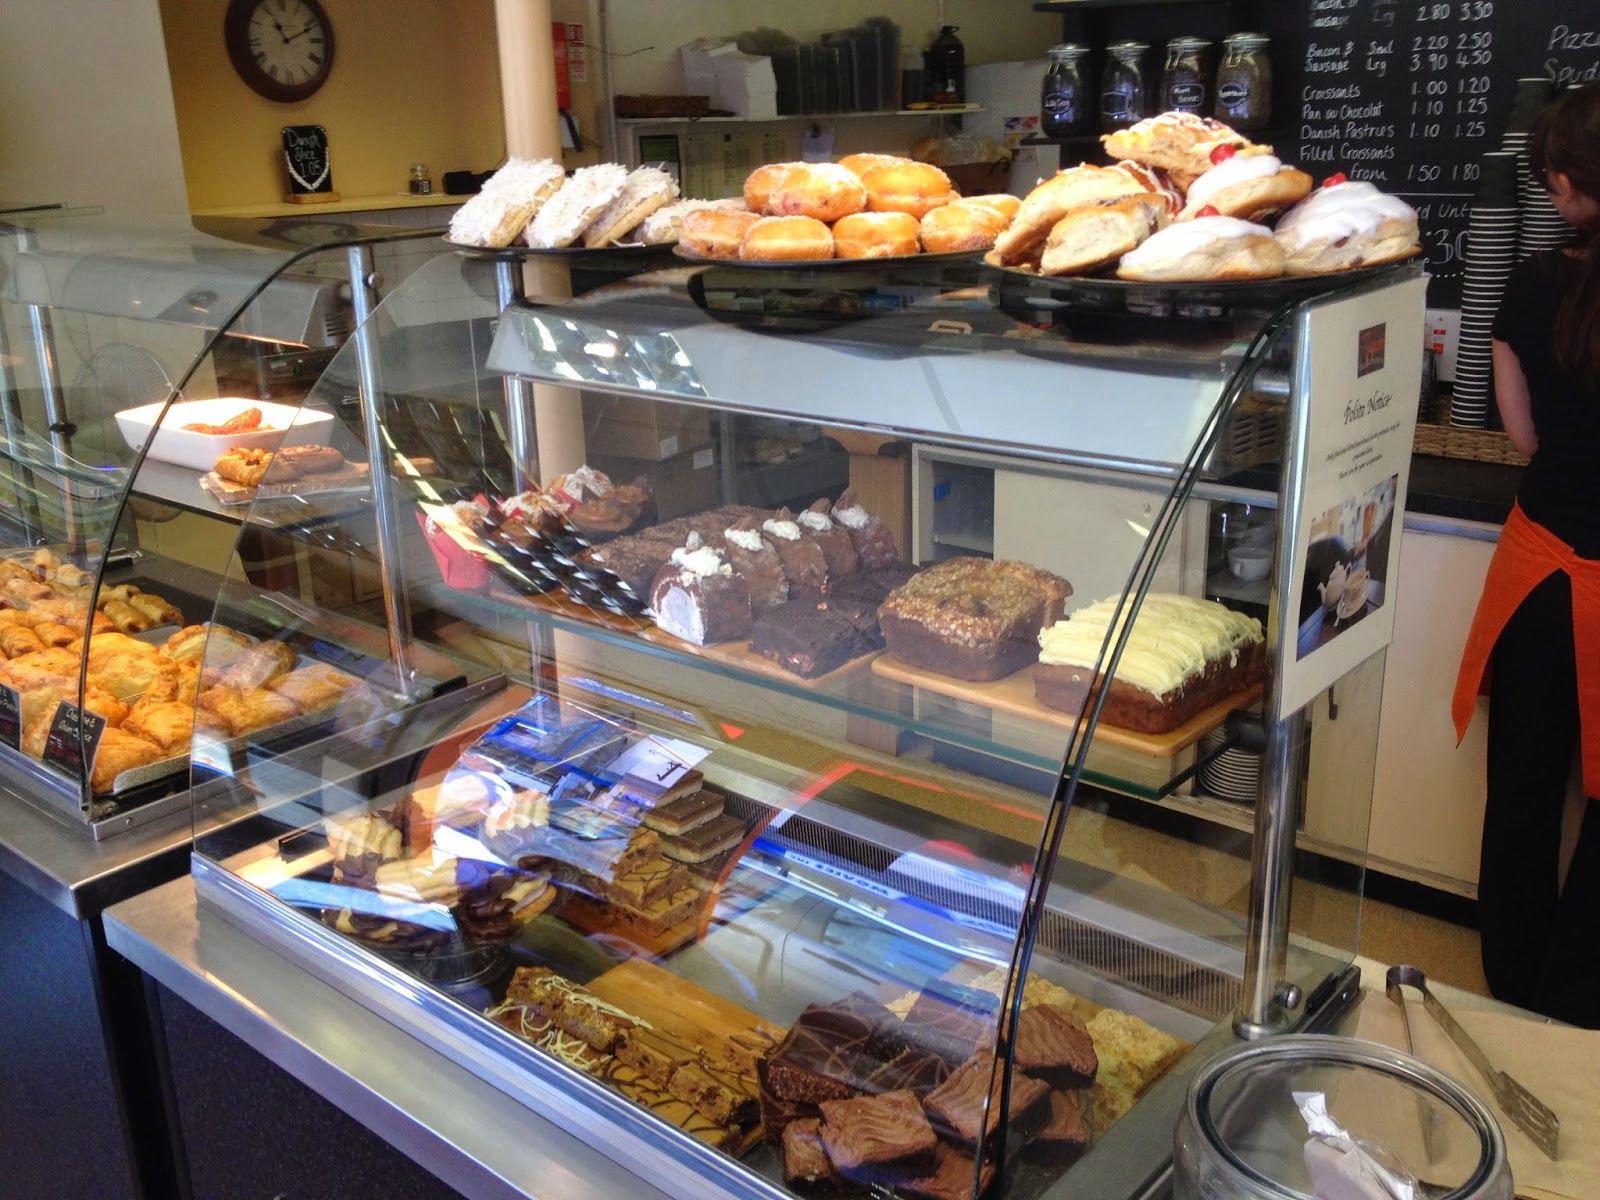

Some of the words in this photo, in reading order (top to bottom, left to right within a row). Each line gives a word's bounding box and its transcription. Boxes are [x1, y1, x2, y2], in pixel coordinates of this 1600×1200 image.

[1306, 43, 1340, 57] Bacon
[1304, 58, 1349, 74] Sausage
[1544, 57, 1600, 88] Spud
[1302, 84, 1361, 101] Croissants
[1340, 100, 1384, 119] Chocolat
[1301, 125, 1341, 139] Danish
[1300, 144, 1335, 161] Filled
[1341, 142, 1395, 159] Croissants
[1350, 162, 1388, 180] from
